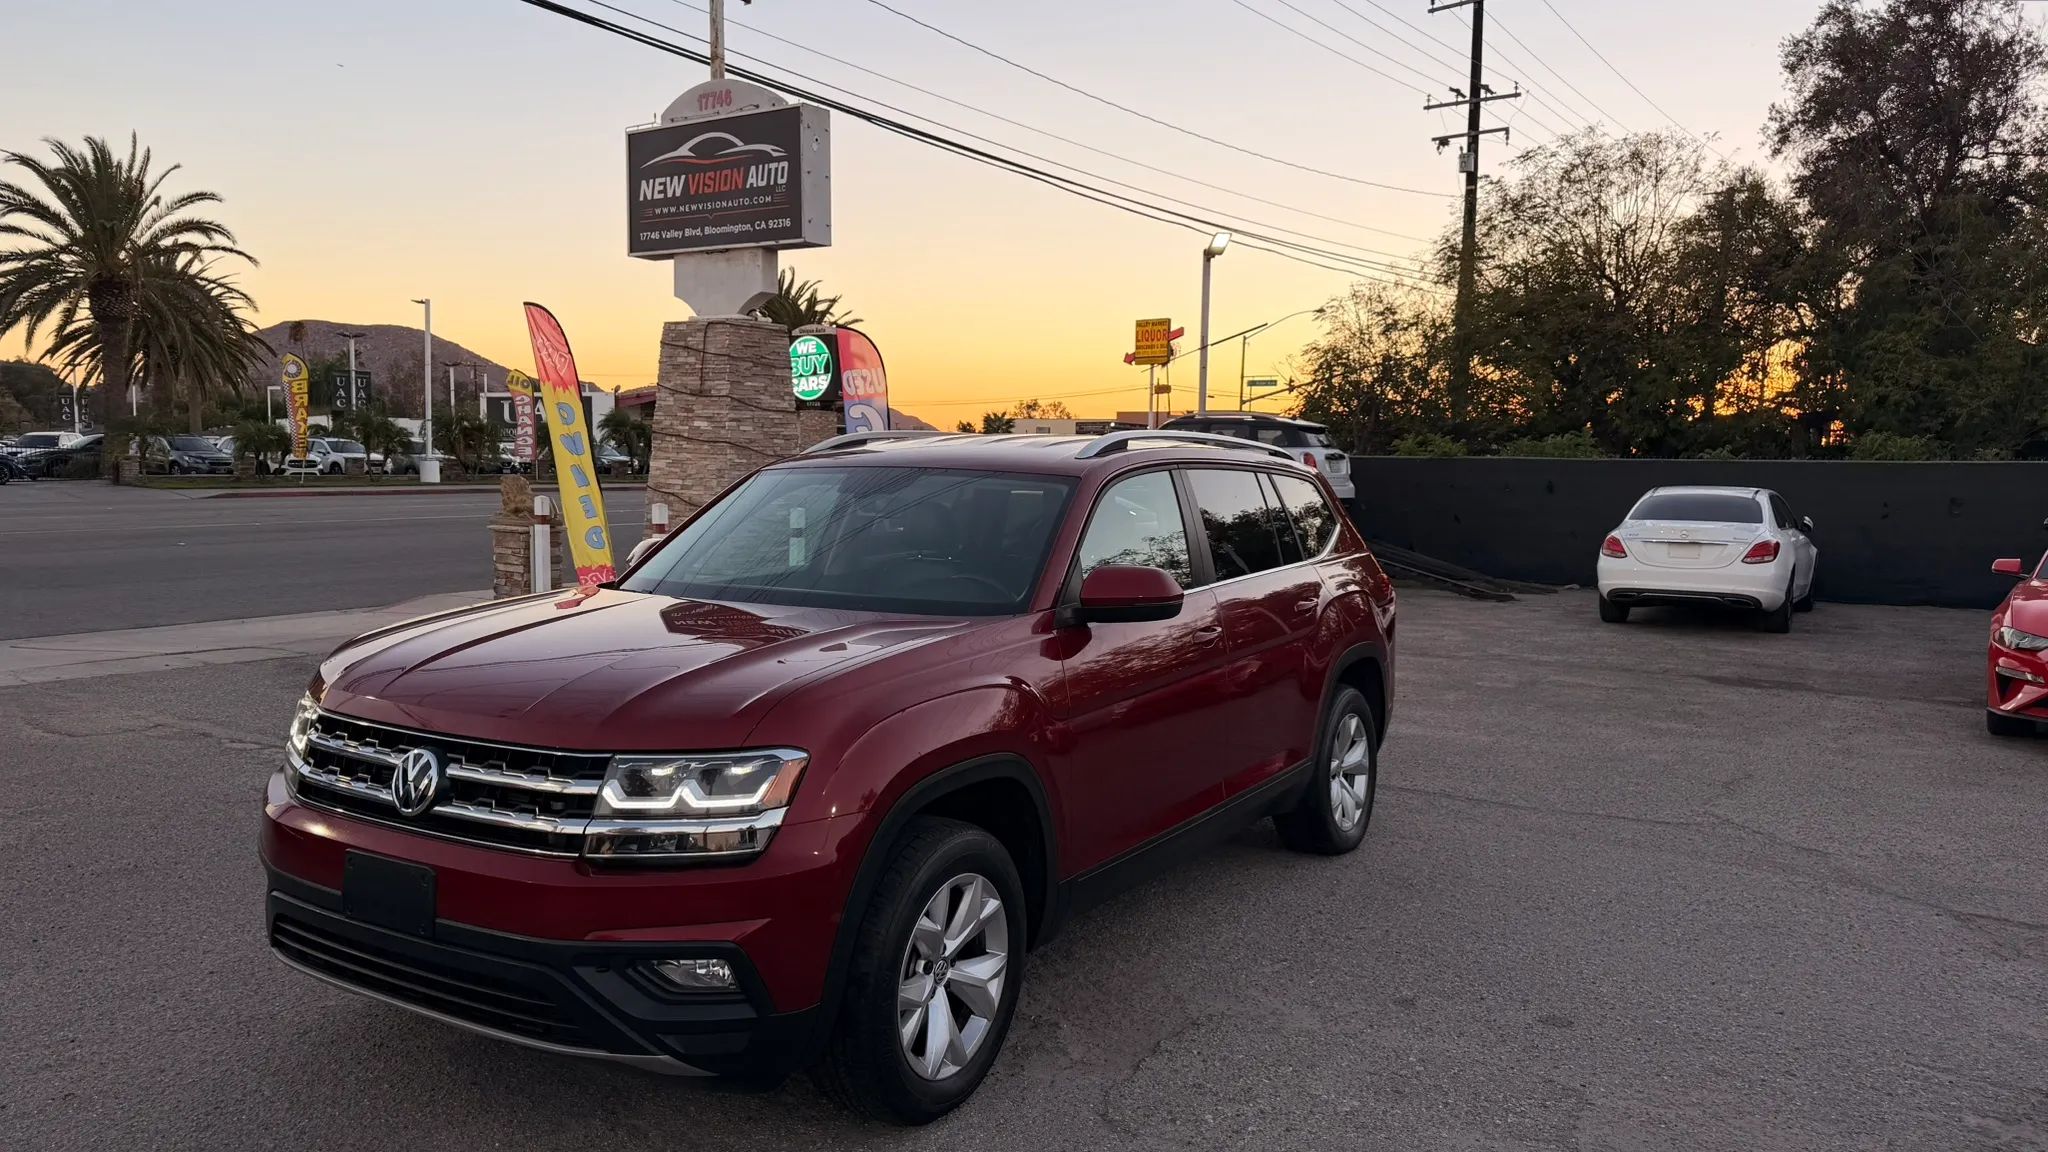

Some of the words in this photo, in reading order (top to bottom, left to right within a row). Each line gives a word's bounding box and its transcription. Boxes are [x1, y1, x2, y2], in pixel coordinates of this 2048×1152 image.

[698, 89, 733, 111] 17746
[640, 175, 686, 201] NEW
[688, 167, 744, 195] VISION
[746, 161, 788, 189] AUTO
[655, 195, 772, 215] WWW.NEWVISIONAUTO.COM
[640, 231, 660, 241] 17746
[661, 229, 683, 239] Valley
[684, 227, 703, 237] Blvd,
[704, 223, 753, 234] Bloomington,
[755, 221, 767, 230] CA
[768, 218, 791, 229] 92316
[1136, 329, 1168, 343] LIQUOR
[795, 341, 817, 355] WE
[790, 354, 829, 378] BUY
[336, 376, 347, 408] UAC
[792, 375, 828, 392] CARS
